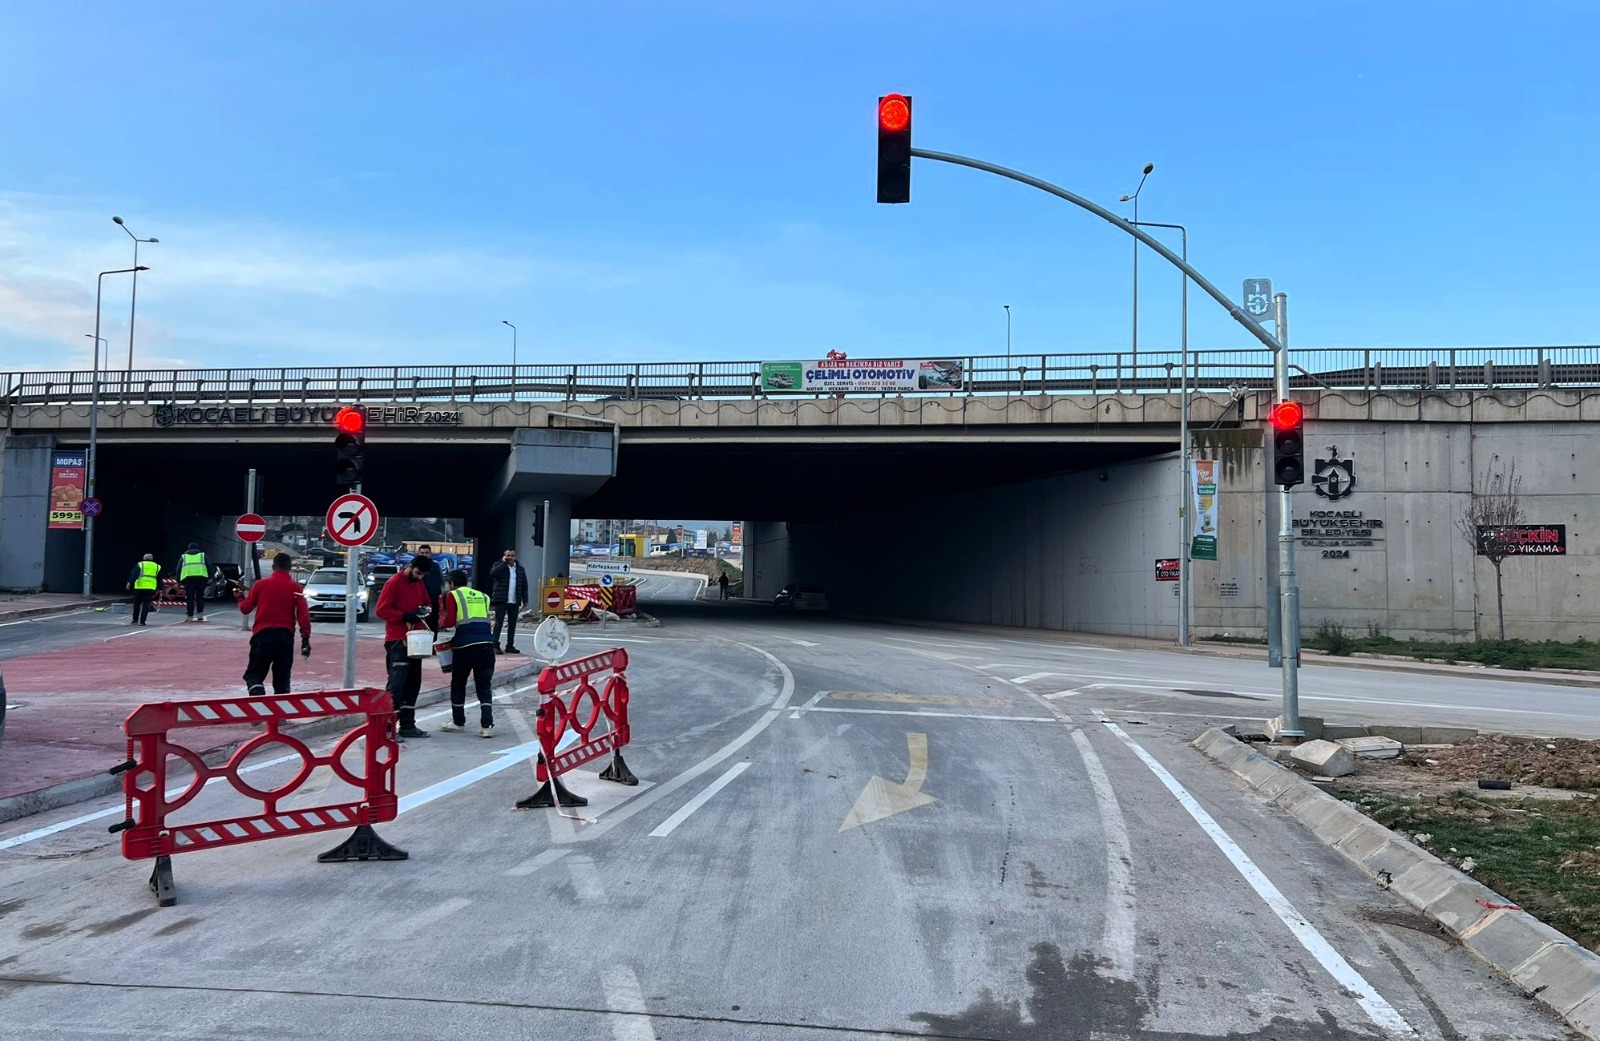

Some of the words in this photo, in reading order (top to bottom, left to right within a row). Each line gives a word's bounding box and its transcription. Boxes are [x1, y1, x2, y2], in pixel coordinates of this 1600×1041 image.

[805, 369, 850, 383] ÇELİMLİ
[852, 369, 916, 380] OTOMOTİV
[177, 407, 267, 423] KOCAELİ
[274, 406, 420, 423] BÜYÜEHİR
[424, 411, 460, 423] 2024
[1292, 519, 1384, 529] BÜYÜKŞEHİR
[1301, 529, 1372, 537] BELEDİYESİ
[1518, 545, 1561, 553] YIKAMA
[1321, 550, 1350, 559] 2024
